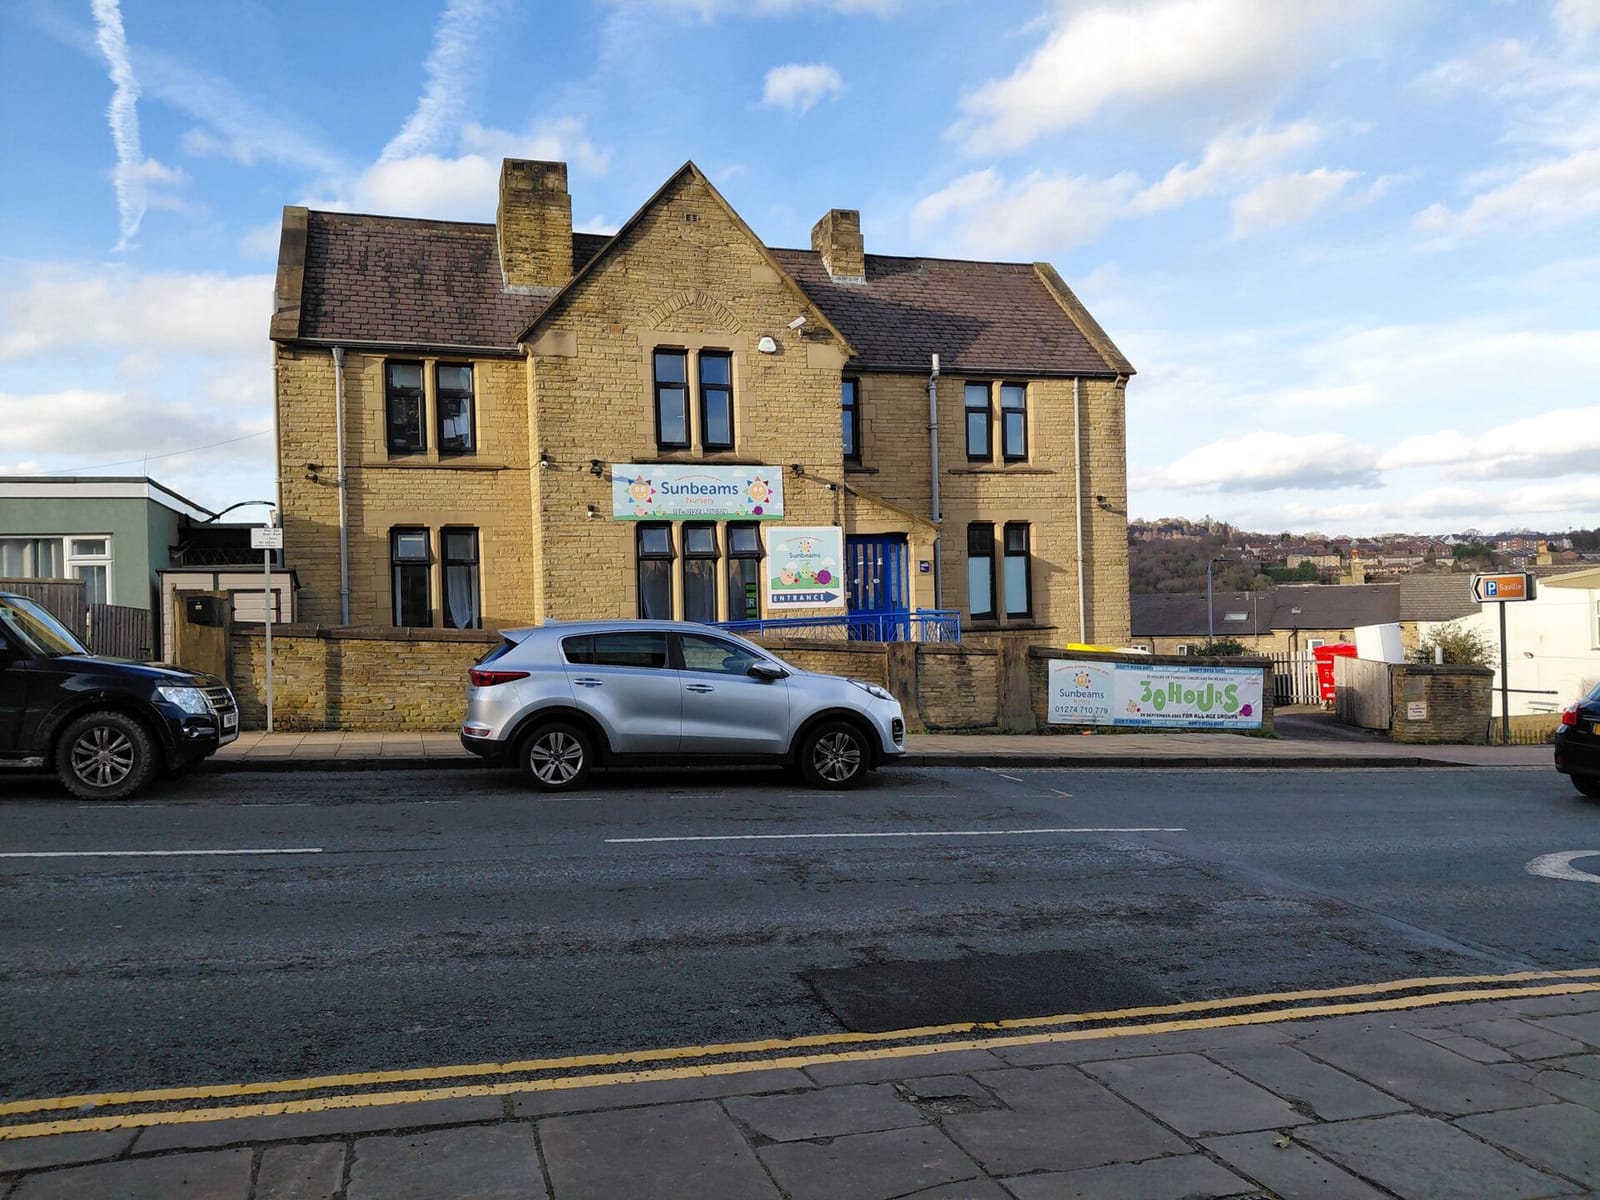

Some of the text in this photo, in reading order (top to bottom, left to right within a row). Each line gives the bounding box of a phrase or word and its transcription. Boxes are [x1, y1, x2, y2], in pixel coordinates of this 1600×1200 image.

[661, 481, 739, 495] Sunbeams
[686, 496, 714, 505] Nursery
[1487, 582, 1496, 595] P
[773, 594, 824, 602] ENTRANCE
[1059, 688, 1105, 699] Sunbeams
[1055, 705, 1108, 715] 01274 710 779
